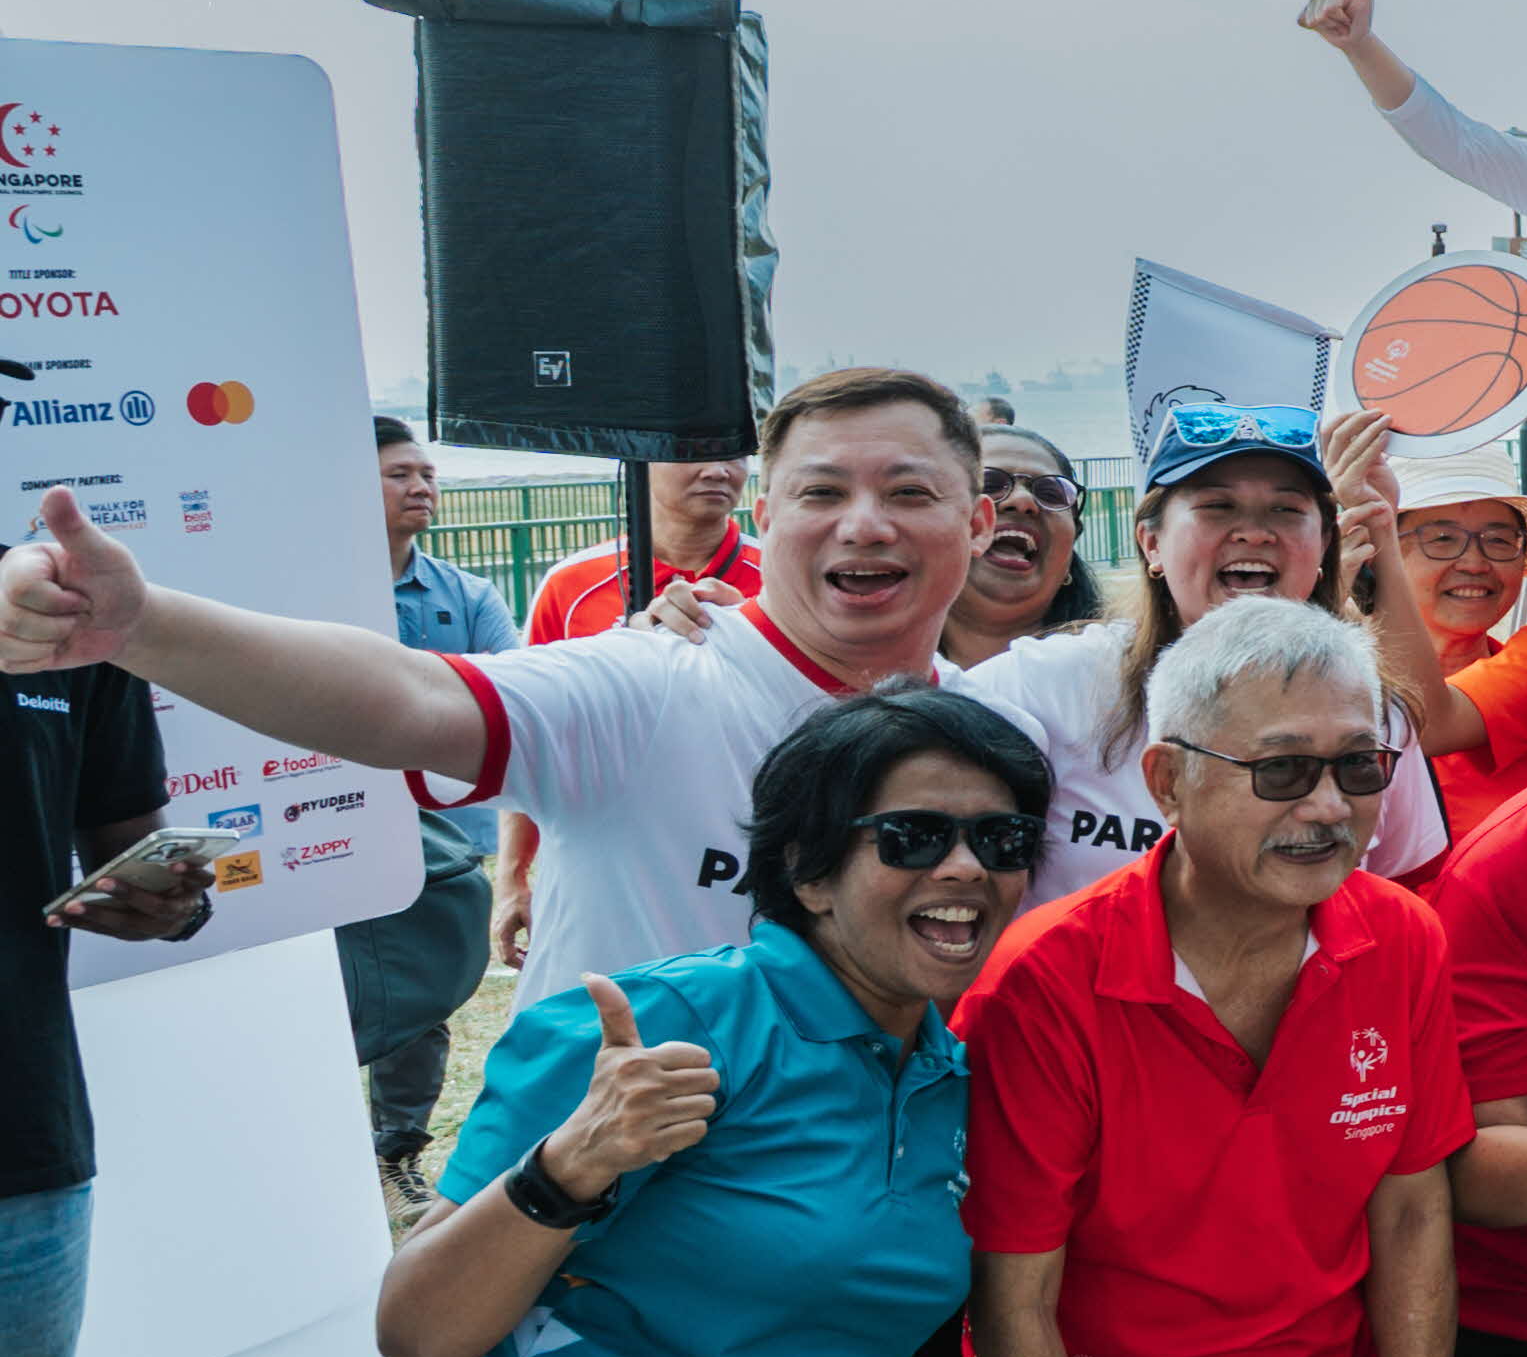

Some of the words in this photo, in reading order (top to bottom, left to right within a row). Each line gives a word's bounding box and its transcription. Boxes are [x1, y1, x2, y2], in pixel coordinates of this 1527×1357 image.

[9, 269, 31, 279] TITLE
[0, 291, 119, 319] OYOTA
[13, 400, 113, 427] Allianz
[88, 503, 119, 513] WALK
[123, 500, 145, 510] FOR
[90, 510, 147, 525] HEALTH
[185, 766, 239, 795] Delfi
[300, 791, 365, 813] RYUDBEN
[335, 801, 365, 813] SPORTS
[301, 837, 353, 859] ZAPPY
